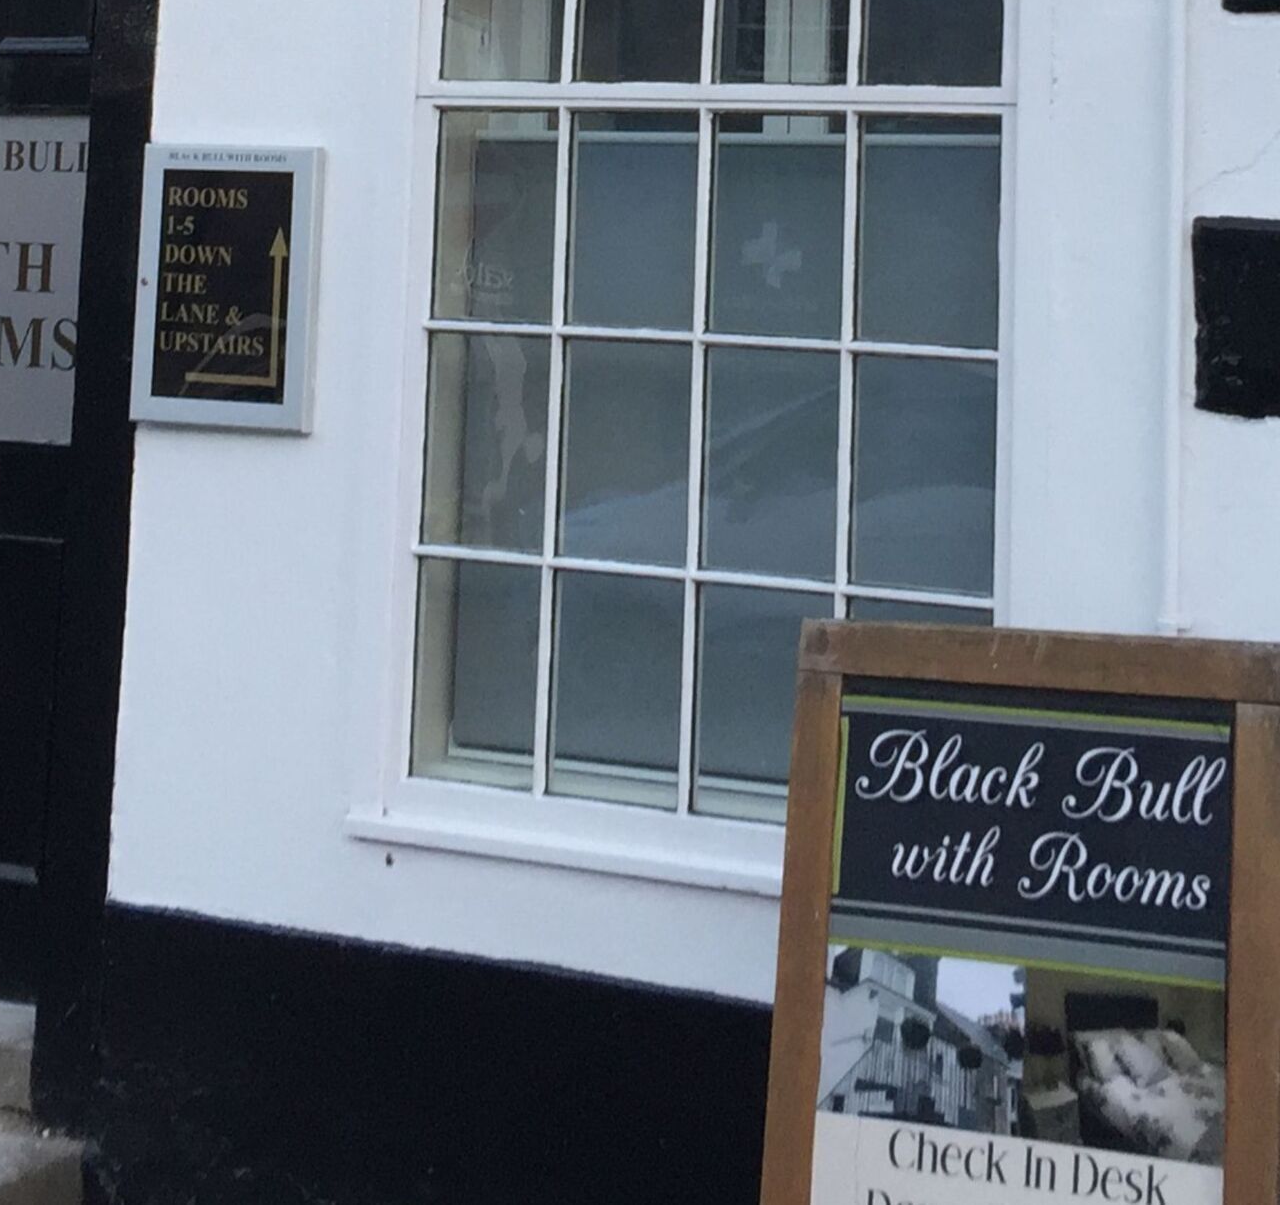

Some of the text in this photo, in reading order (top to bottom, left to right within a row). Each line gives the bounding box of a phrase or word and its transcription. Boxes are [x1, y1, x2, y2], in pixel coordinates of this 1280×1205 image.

[168, 185, 249, 210] ROOMS
[166, 215, 195, 236] 1-5
[164, 243, 233, 267] DOWN
[163, 273, 208, 295] THE
[160, 302, 244, 327] LANE &
[158, 330, 265, 357] UPSTAIRS
[854, 729, 1227, 826] Black Bull
[890, 825, 1212, 911] with Rooms
[888, 1128, 1170, 1205] Check In Desk
